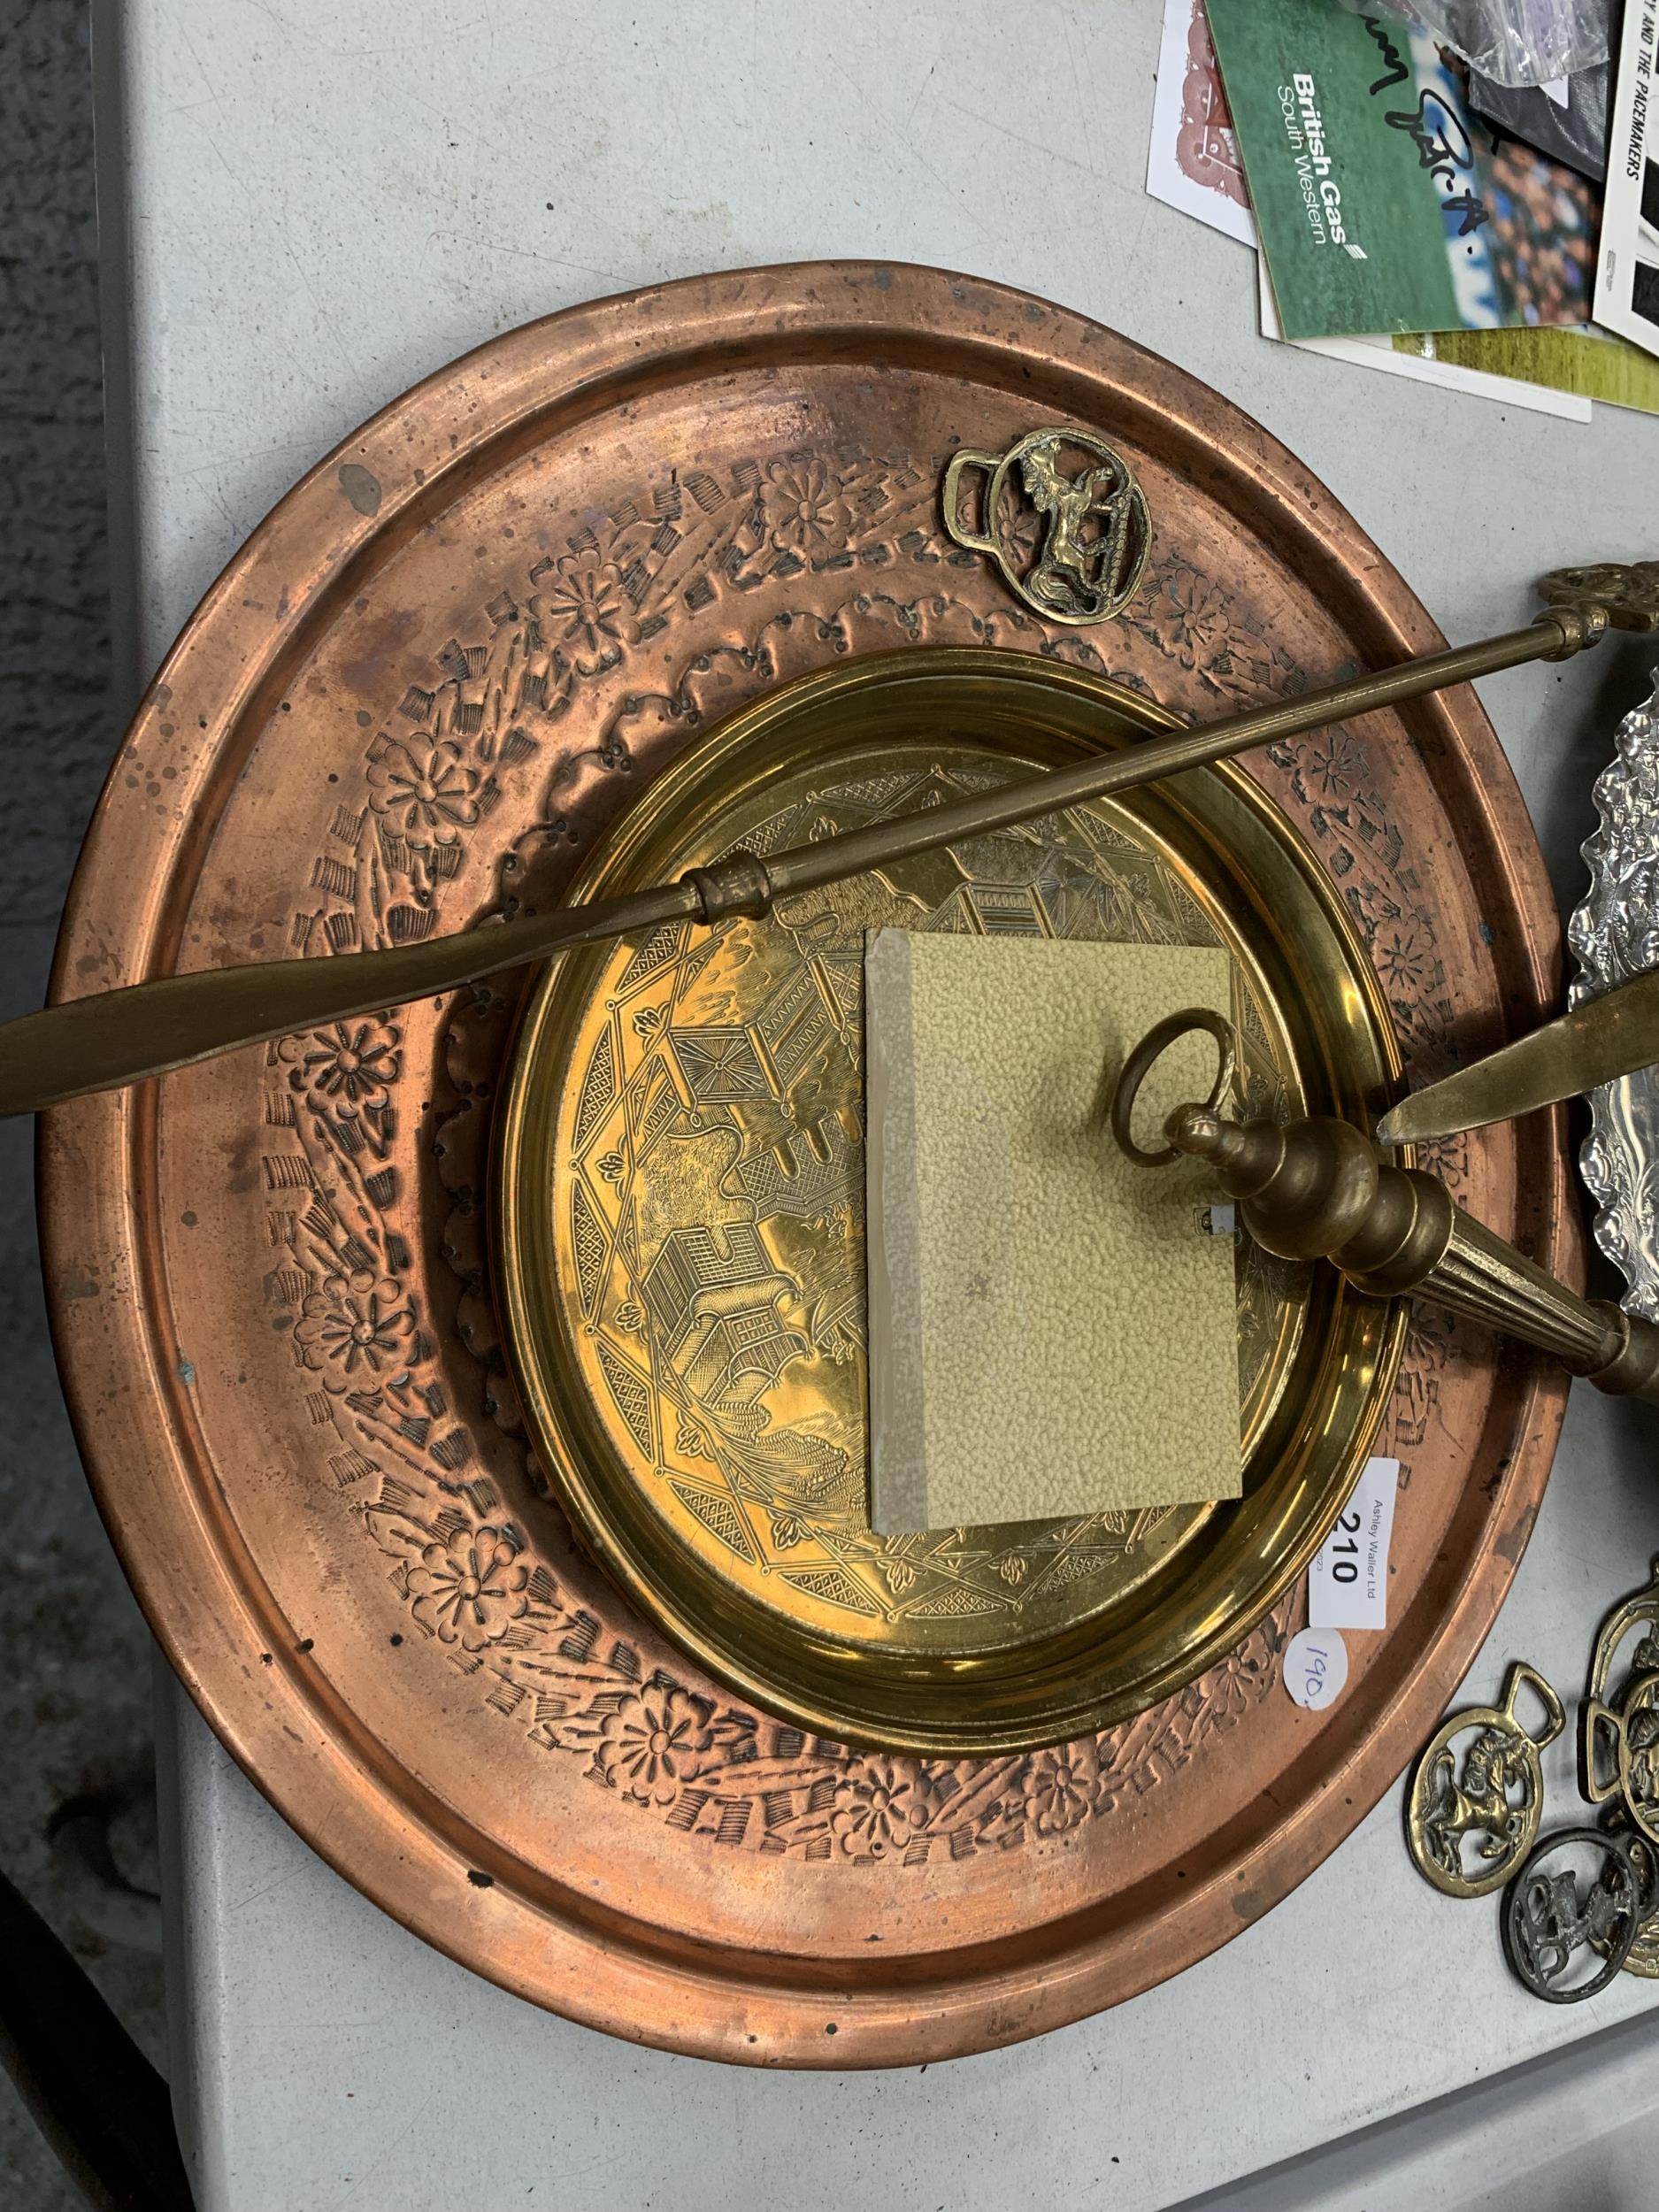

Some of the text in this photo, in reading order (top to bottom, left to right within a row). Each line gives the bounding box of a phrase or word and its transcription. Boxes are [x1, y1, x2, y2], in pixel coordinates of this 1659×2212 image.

[1637, 49, 1652, 79] THE
[1640, 13, 1655, 45] AND
[1278, 85, 1326, 244] South Western
[1293, 73, 1346, 244] British Gas
[1626, 80, 1649, 180] PACEMAKERS
[1333, 1512, 1361, 1583] 210
[1367, 1500, 1383, 1599] Ashley Waller Ltd
